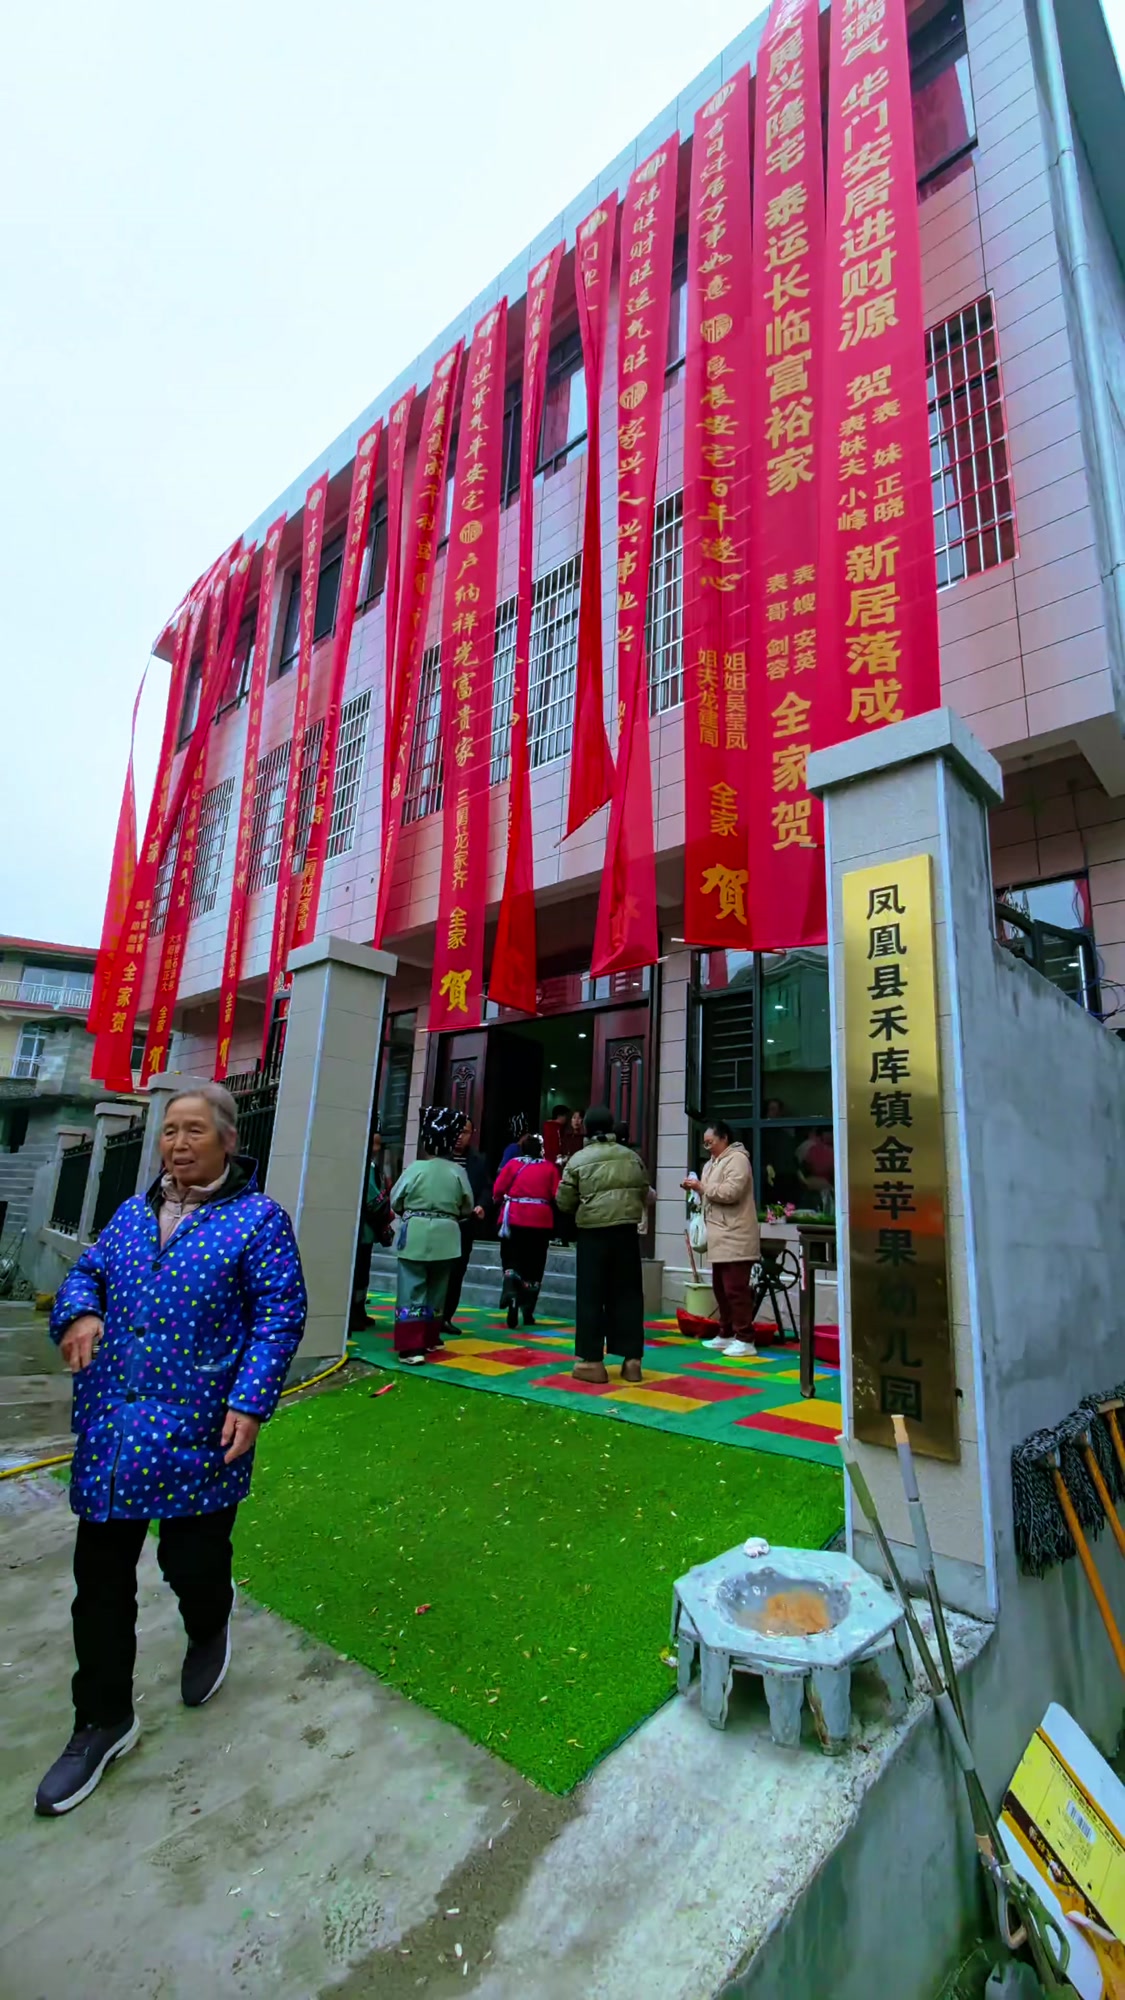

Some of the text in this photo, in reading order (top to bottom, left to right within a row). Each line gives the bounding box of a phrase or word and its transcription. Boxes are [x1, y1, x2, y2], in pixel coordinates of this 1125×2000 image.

[838, 66, 900, 352] 华门安居进财源
[763, 180, 816, 497] 泰运长临富裕家
[846, 364, 893, 411] 贺
[844, 535, 906, 725] 新居落成
[708, 781, 739, 837] 全家
[771, 691, 817, 851] 全家贺
[109, 960, 138, 1034] 全家贺
[447, 906, 468, 950] 全家
[866, 883, 923, 1422] 凤凰县禾库镇金苹果幼儿园
